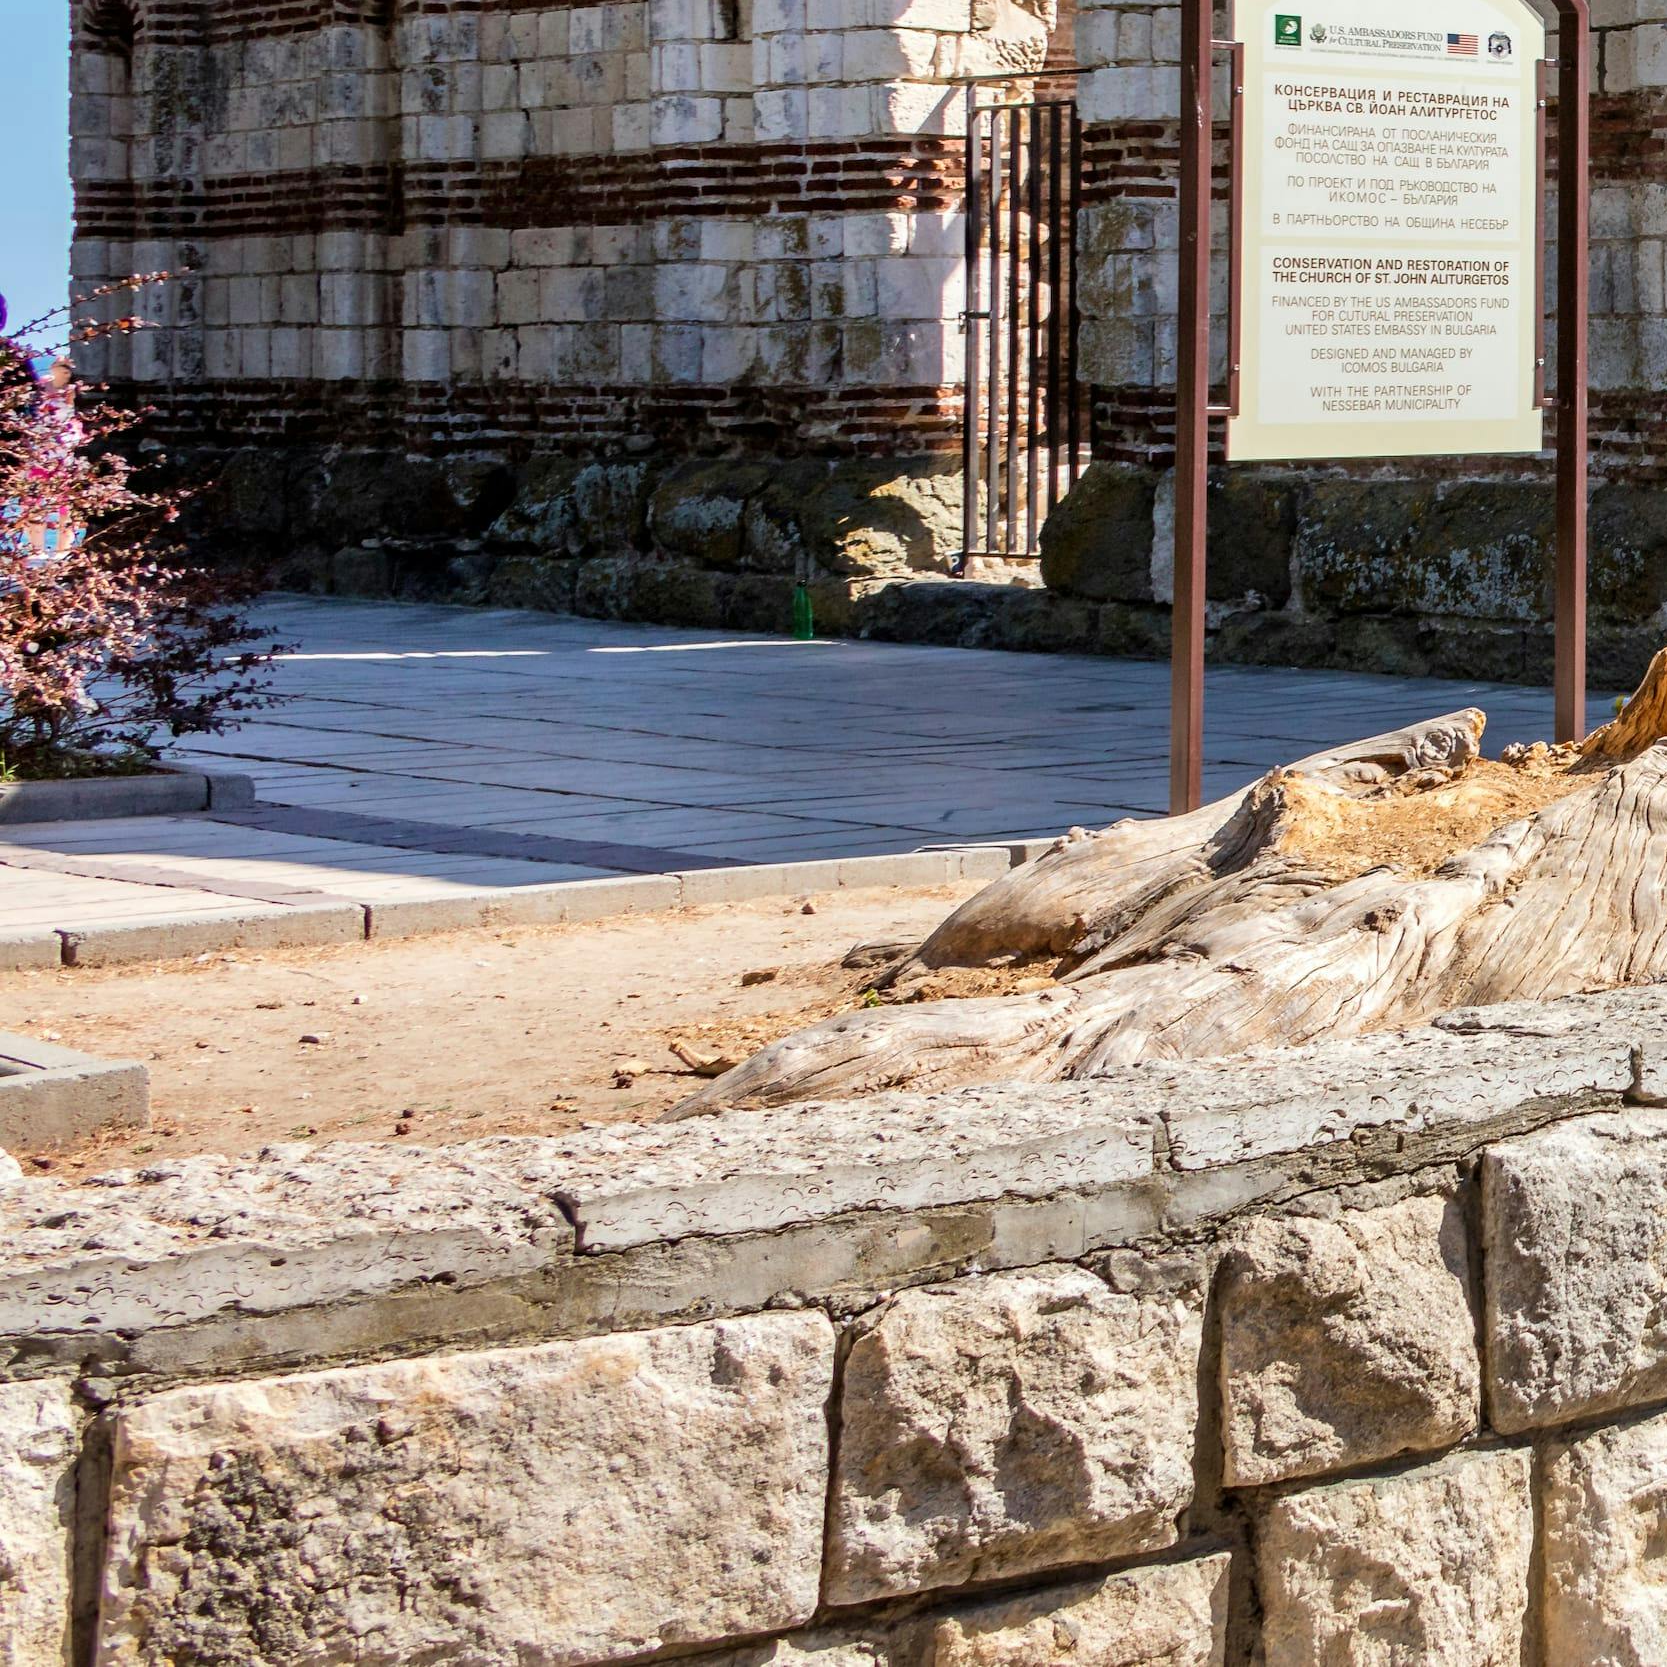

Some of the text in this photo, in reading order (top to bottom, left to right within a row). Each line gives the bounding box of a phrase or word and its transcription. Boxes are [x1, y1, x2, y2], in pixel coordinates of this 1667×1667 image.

[1330, 26, 1442, 41] U.S. AMBASSADORS FUND
[1338, 36, 1382, 48] CULTURAL
[1382, 39, 1441, 51] PRESERVATION
[1275, 84, 1509, 108] КОНСЕРВАЦИЯ И РЕСТАВРАЦИЯ НА
[1288, 100, 1497, 121] ЦЪРКВА СВ. ЙОАН АЛИТУРГЕТОС
[1288, 123, 1496, 144] ФИНАНСИРАНА ОТ ПОСЛАНИЧЕСКИЯ
[1275, 137, 1508, 158] ФОНД НА САЩ ЗА ОПАЗВАНЕ НА КУЛТУРАТА
[1296, 152, 1489, 170] ПОСОЛСТВО НА САЩ В БЪЛГАРИЯ
[1288, 176, 1496, 195] ПО ПРОЕКТ И ПОД РЪКОВОДСТВО НА
[1330, 192, 1386, 204] ИКОМОС
[1403, 194, 1457, 206] БЪЛГАРИЯ
[1273, 214, 1509, 230] В ПАРТНЬОРСТВО НА ОБЩИНА НЕСЕБЪР
[1273, 258, 1509, 272] CONSERVATION AND RESTORATION OF
[1273, 272, 1509, 285] THE CHURCH OF ST. JOHN ALITURGETOS
[1272, 296, 1509, 308] FINANCED BY THE US AMBASSADORS FUND
[1312, 310, 1472, 322] FOR CUTURAL PRESERVATION
[1286, 325, 1496, 335] UNITED STATES EMBASSY IN BULGARIA
[1312, 349, 1472, 359] DESIGNED AND MANAGED BY
[1342, 362, 1444, 373] ICOMOS BULGARIA
[1311, 385, 1471, 397] WITH THE PARTNERSHIP OF
[1323, 399, 1461, 411] NESSEBAR MUNICIPALITY
